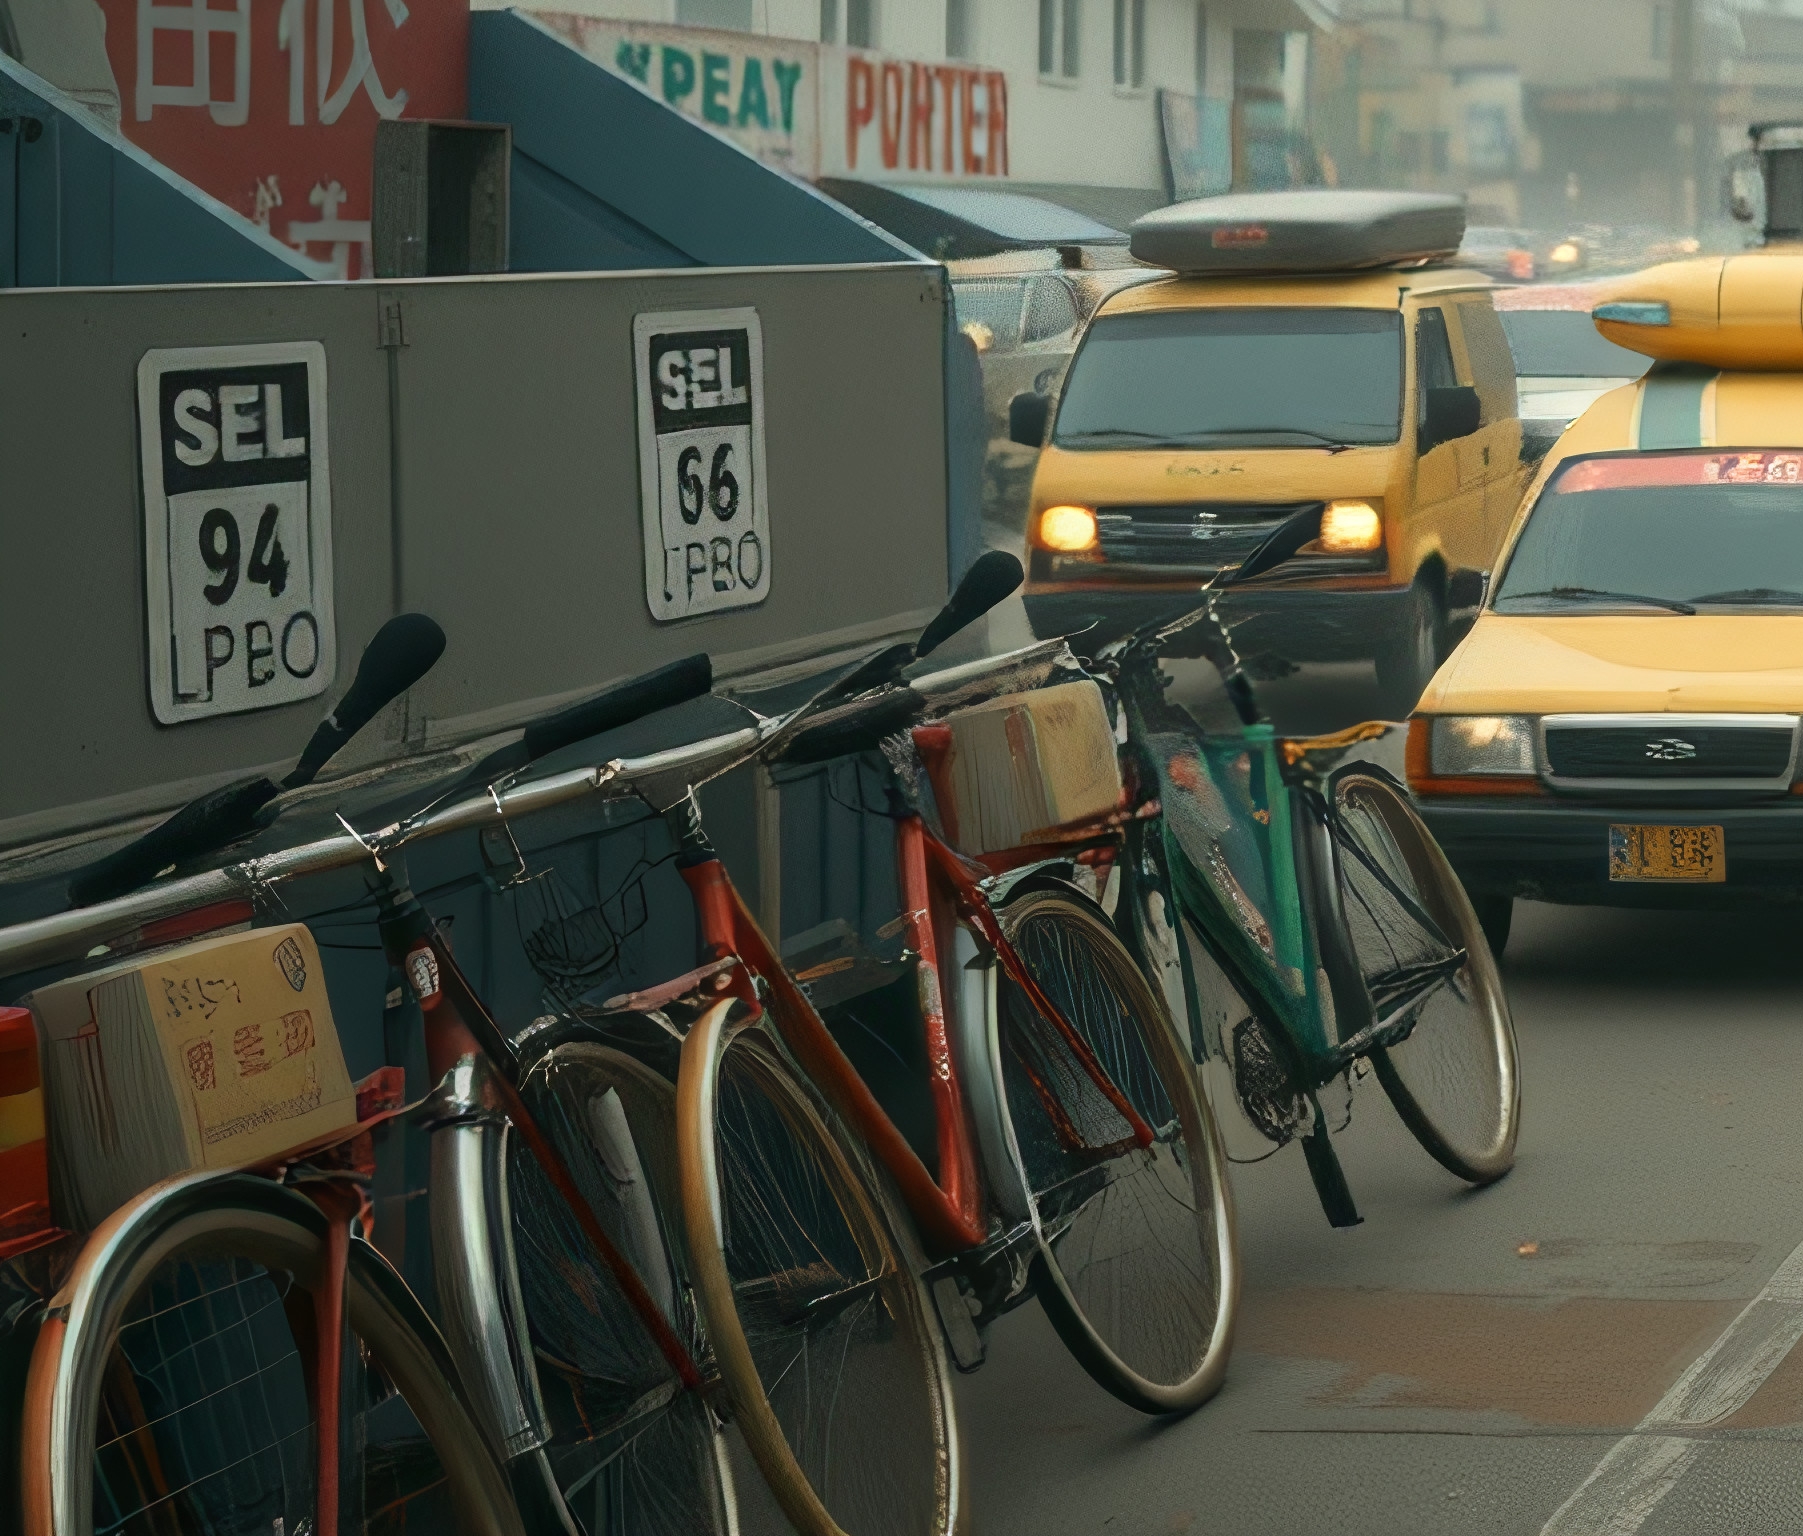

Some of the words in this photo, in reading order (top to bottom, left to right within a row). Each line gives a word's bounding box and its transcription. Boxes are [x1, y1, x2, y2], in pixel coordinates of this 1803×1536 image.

[174, 383, 306, 466] SEL
[677, 442, 740, 525] 66
[199, 502, 290, 605] 94
